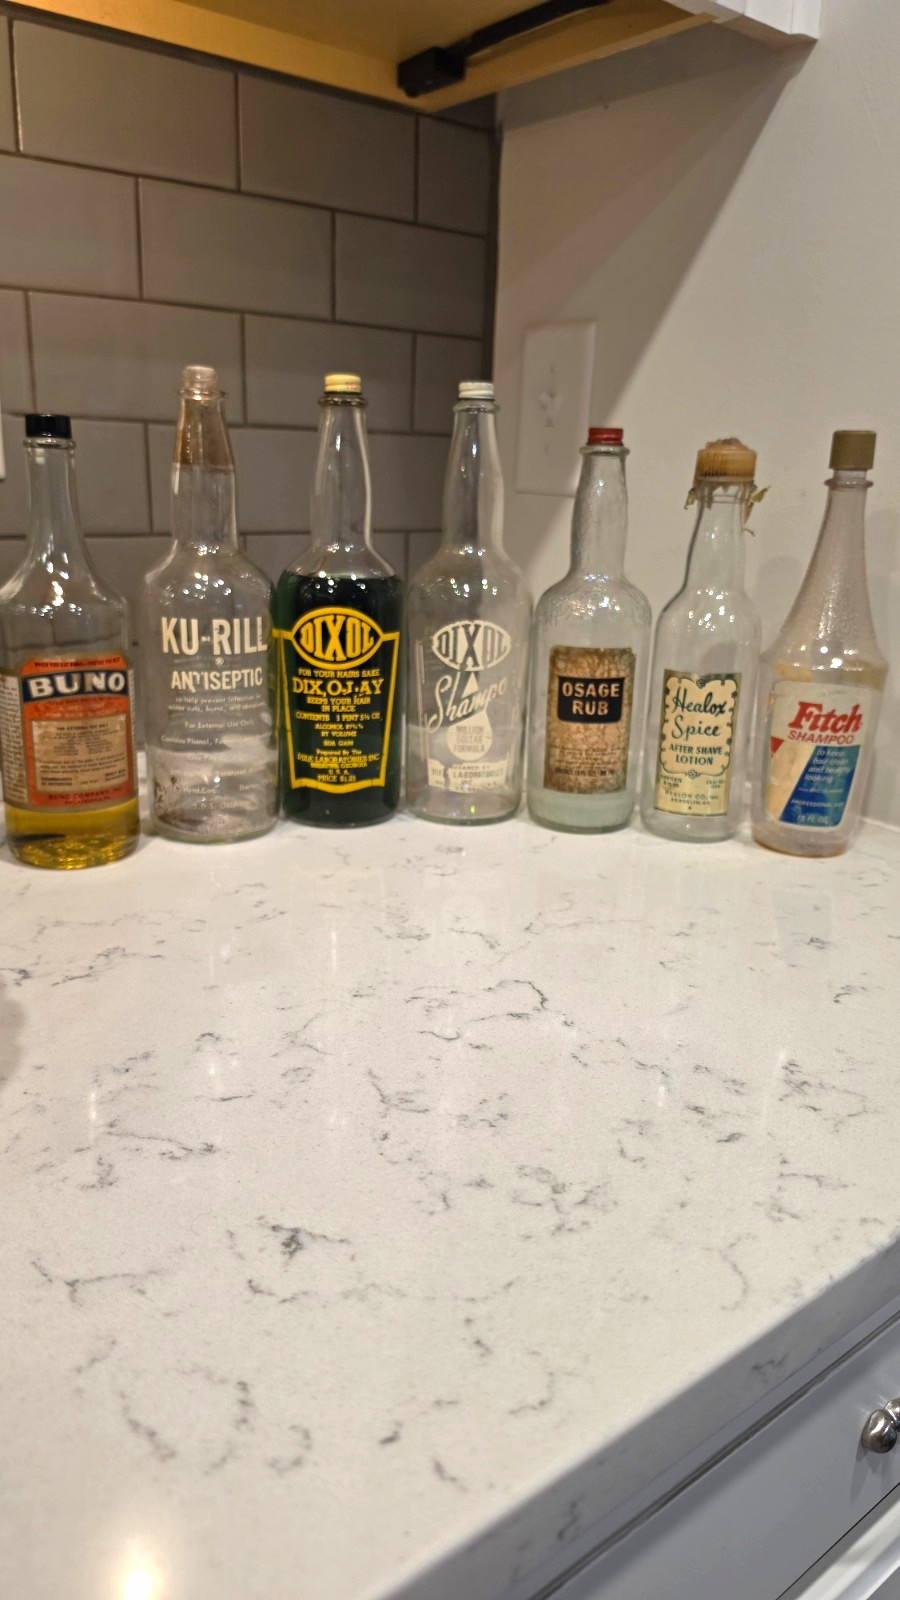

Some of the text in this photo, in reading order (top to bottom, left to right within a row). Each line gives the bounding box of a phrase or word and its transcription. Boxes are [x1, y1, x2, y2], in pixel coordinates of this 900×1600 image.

[161, 616, 268, 656] KU-RILL
[300, 614, 375, 662] DIXOL
[437, 623, 509, 668] DIXOL
[298, 668, 312, 677] FOR
[313, 669, 335, 678] YOUR
[361, 668, 381, 678] SAKE
[27, 672, 126, 699] BUNO
[171, 667, 264, 693] ANTISEPTIC
[561, 681, 621, 698] OSAGE
[184, 696, 199, 705] help
[200, 697, 226, 705] prevent
[306, 695, 328, 705] KEEPS
[330, 697, 352, 705] YOUR
[672, 686, 727, 717] Healox
[321, 704, 356, 713] IN PLACE
[572, 701, 609, 716] RUB
[295, 711, 330, 721] CONTENTS
[787, 701, 864, 734] Fitch
[184, 721, 196, 729] For
[197, 721, 226, 730] External
[227, 721, 239, 729] Use
[671, 714, 721, 742] Spice
[331, 730, 358, 738] VOLUME
[787, 730, 855, 745] SHAMPOO
[452, 744, 485, 753] FORMULA
[669, 743, 723, 756] AFTER SHAVE
[675, 754, 714, 766] LOTION
[812, 757, 828, 765] hair
[317, 774, 338, 783] PRICE
[803, 774, 833, 784] looking
